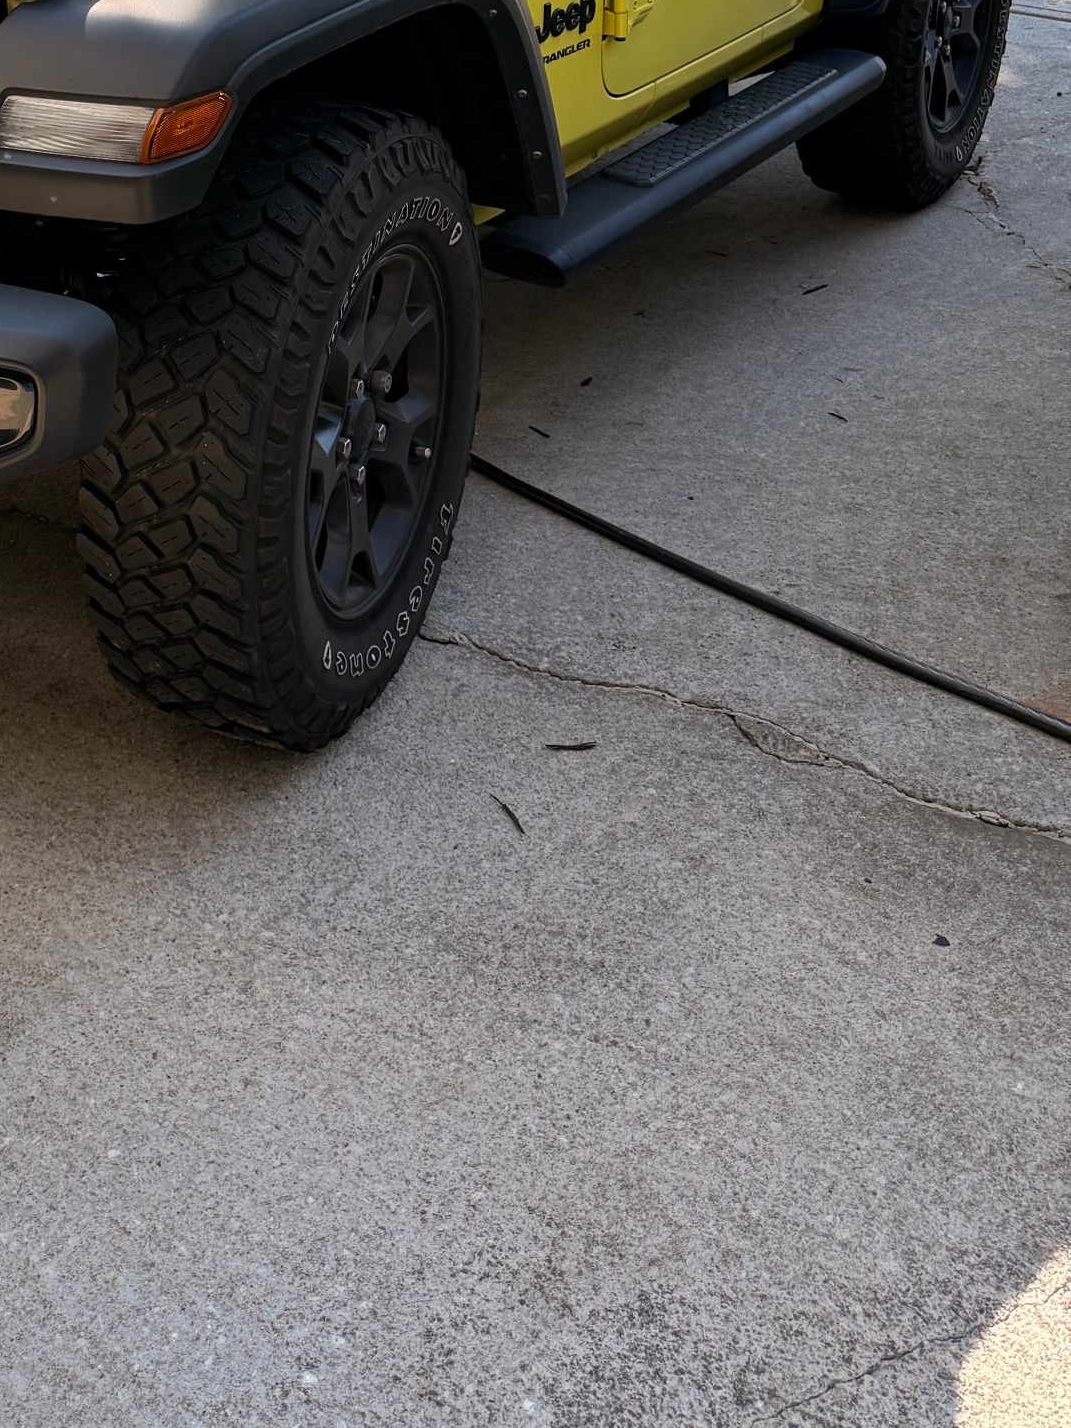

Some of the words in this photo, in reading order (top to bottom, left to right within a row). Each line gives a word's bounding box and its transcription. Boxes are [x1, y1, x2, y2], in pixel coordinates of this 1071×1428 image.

[543, 39, 591, 64] RANGLER
[327, 197, 454, 354] DESTINATION
[336, 503, 454, 678] Firestone
